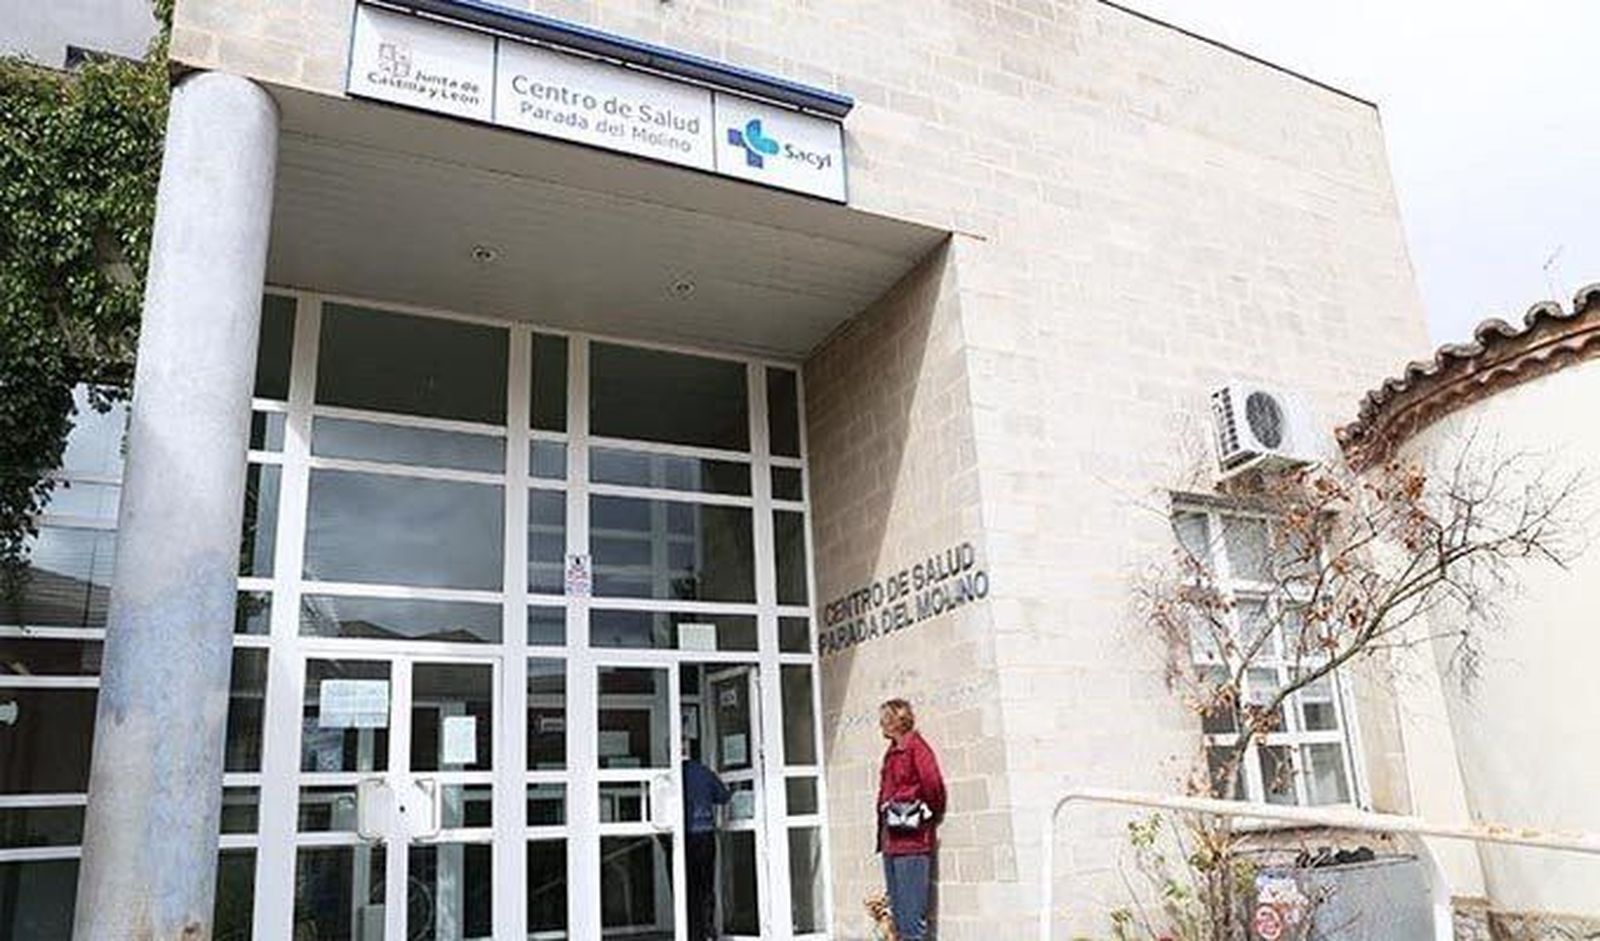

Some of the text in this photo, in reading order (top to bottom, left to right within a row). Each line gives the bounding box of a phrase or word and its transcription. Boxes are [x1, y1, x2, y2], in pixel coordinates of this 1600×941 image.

[461, 78, 480, 93] de
[511, 74, 700, 135] Centro de Salud
[520, 101, 692, 152] Parada del Molino
[784, 143, 832, 170] Sacyl
[824, 542, 975, 627] CENTRO DE SALUD
[818, 570, 990, 657] PARADA DEL MOLINO
